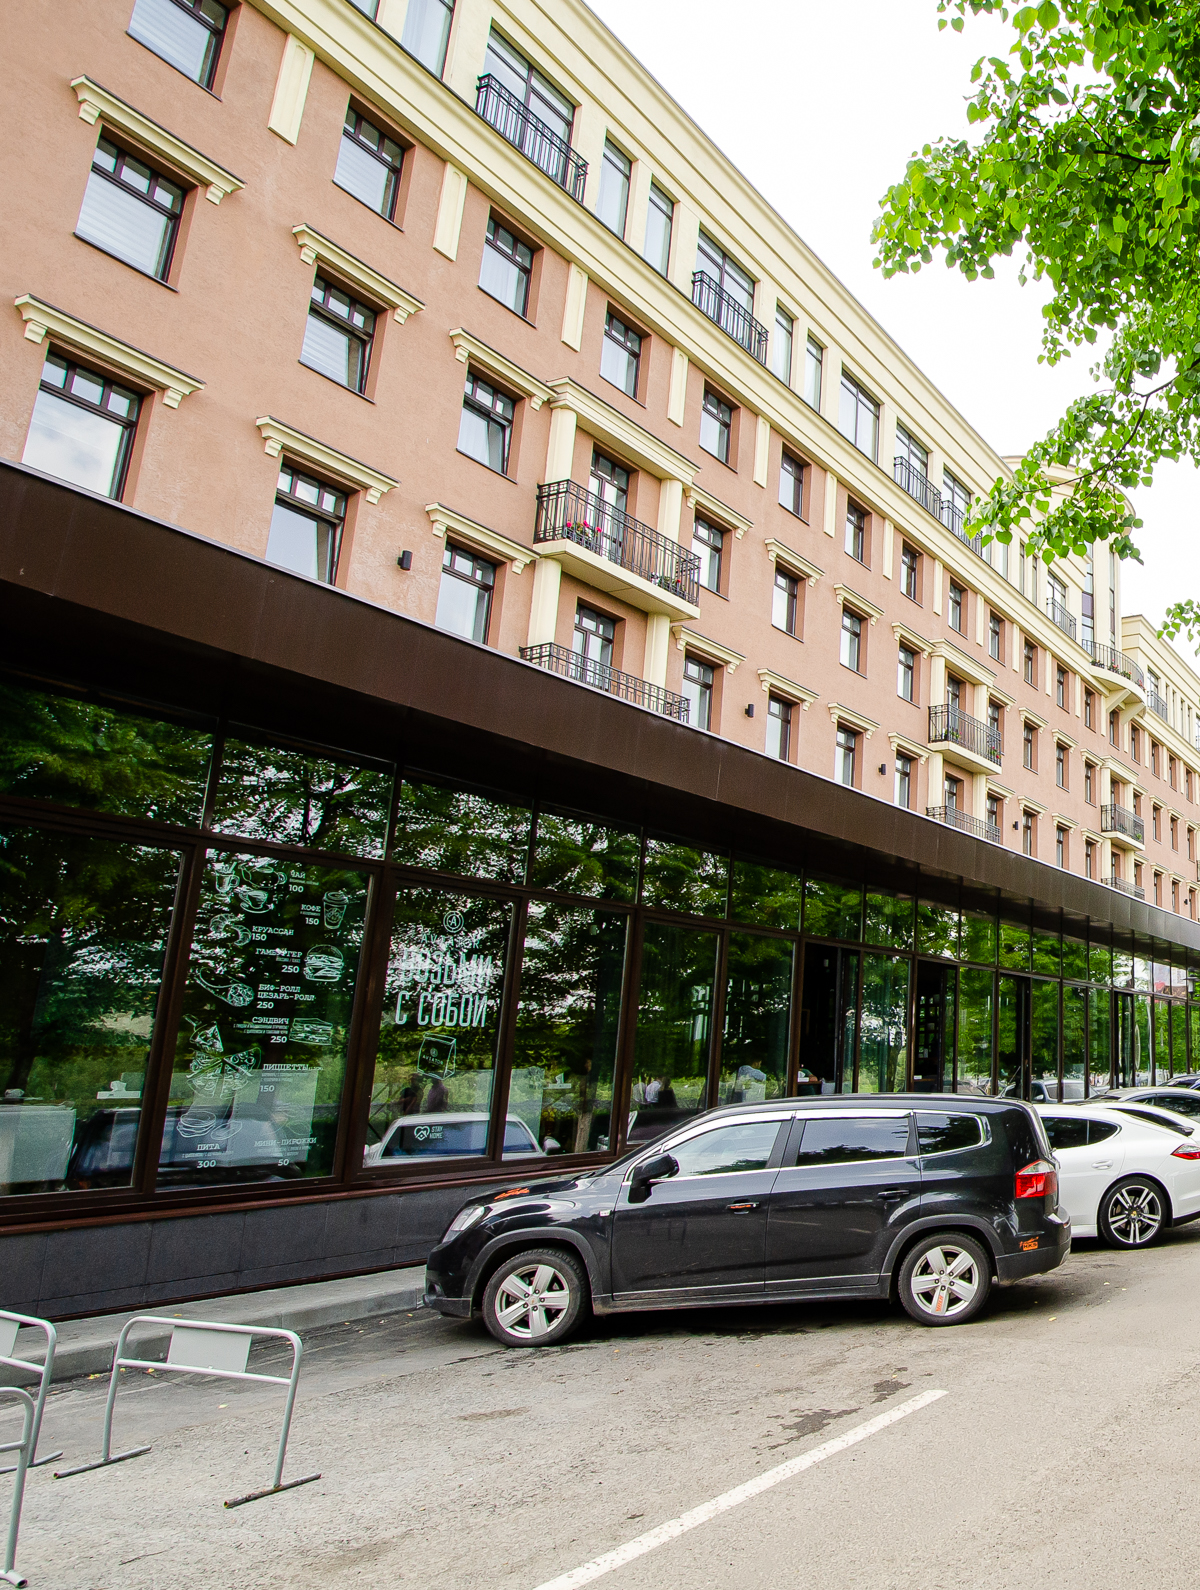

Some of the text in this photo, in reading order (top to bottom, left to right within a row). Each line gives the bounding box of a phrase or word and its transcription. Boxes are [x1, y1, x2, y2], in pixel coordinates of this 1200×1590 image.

[290, 869, 306, 879] ЧАЙ
[288, 884, 304, 893] 100
[301, 904, 321, 913] КОФЕ
[305, 917, 320, 925] 150
[252, 925, 294, 936] КРУАССАН
[252, 933, 267, 941] 150
[281, 965, 300, 973] 250
[256, 1001, 274, 1010] 250
[395, 990, 488, 1028] С СОБОЙ
[252, 1016, 290, 1025] СЭНДВИЧ
[270, 1035, 288, 1043] 250
[259, 1084, 275, 1092] 150
[196, 1143, 221, 1151] ПИТА
[196, 1159, 217, 1169] 300
[277, 1158, 290, 1167] 50
